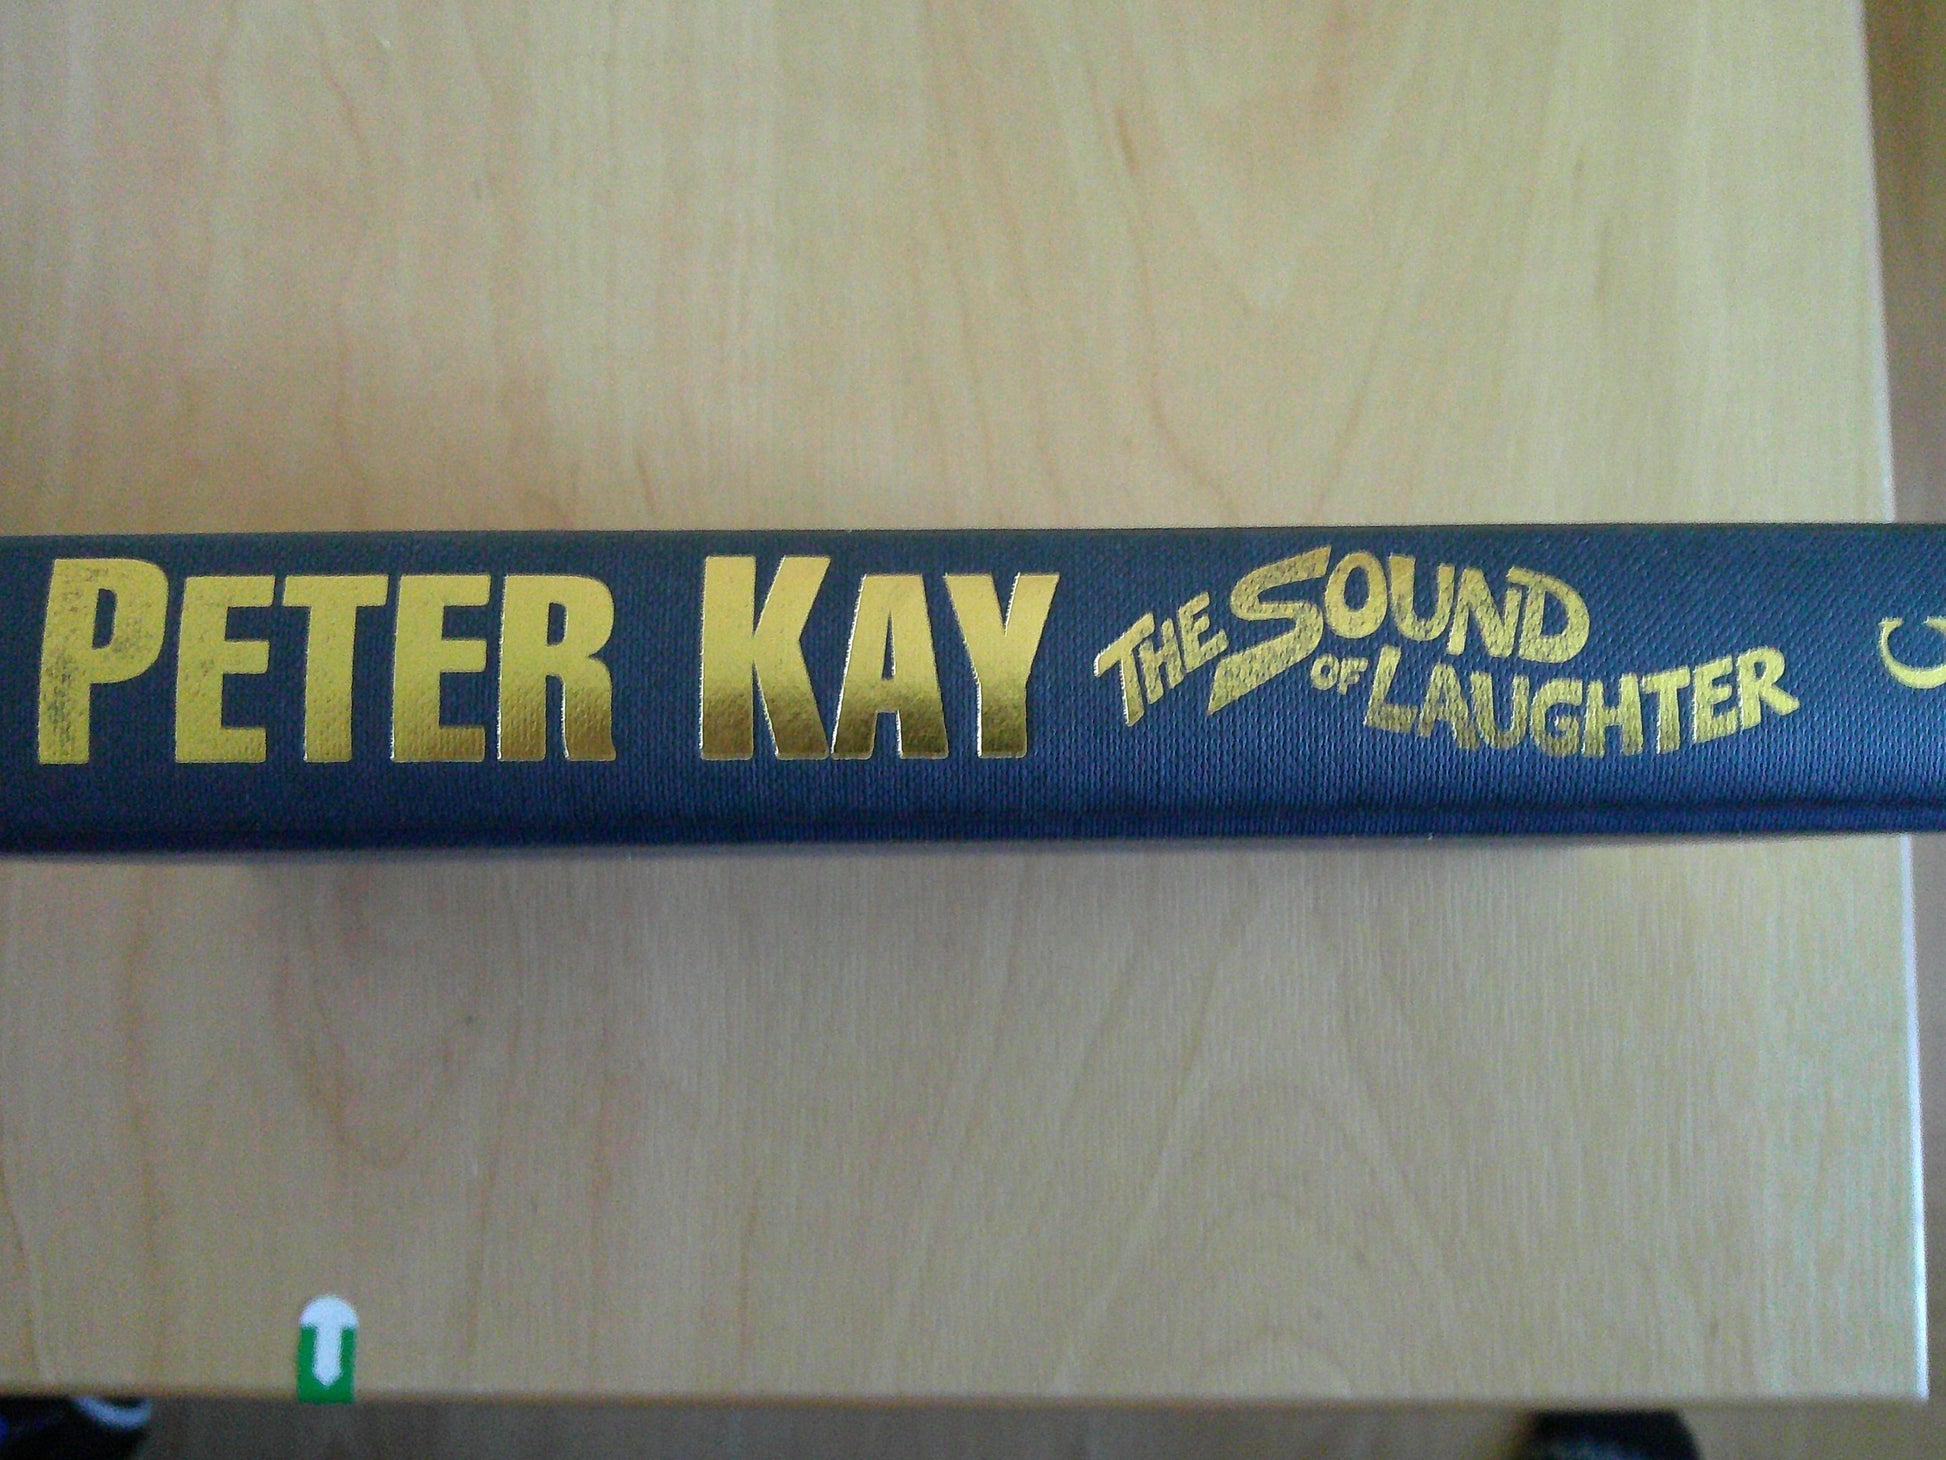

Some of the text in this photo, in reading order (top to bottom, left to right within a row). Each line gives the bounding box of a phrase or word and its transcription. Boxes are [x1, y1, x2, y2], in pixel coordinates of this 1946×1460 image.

[36, 554, 1060, 765] PETER KAY
[1093, 546, 1592, 727] THE SOUND
[1310, 646, 1800, 758] OF LAUGHTER
